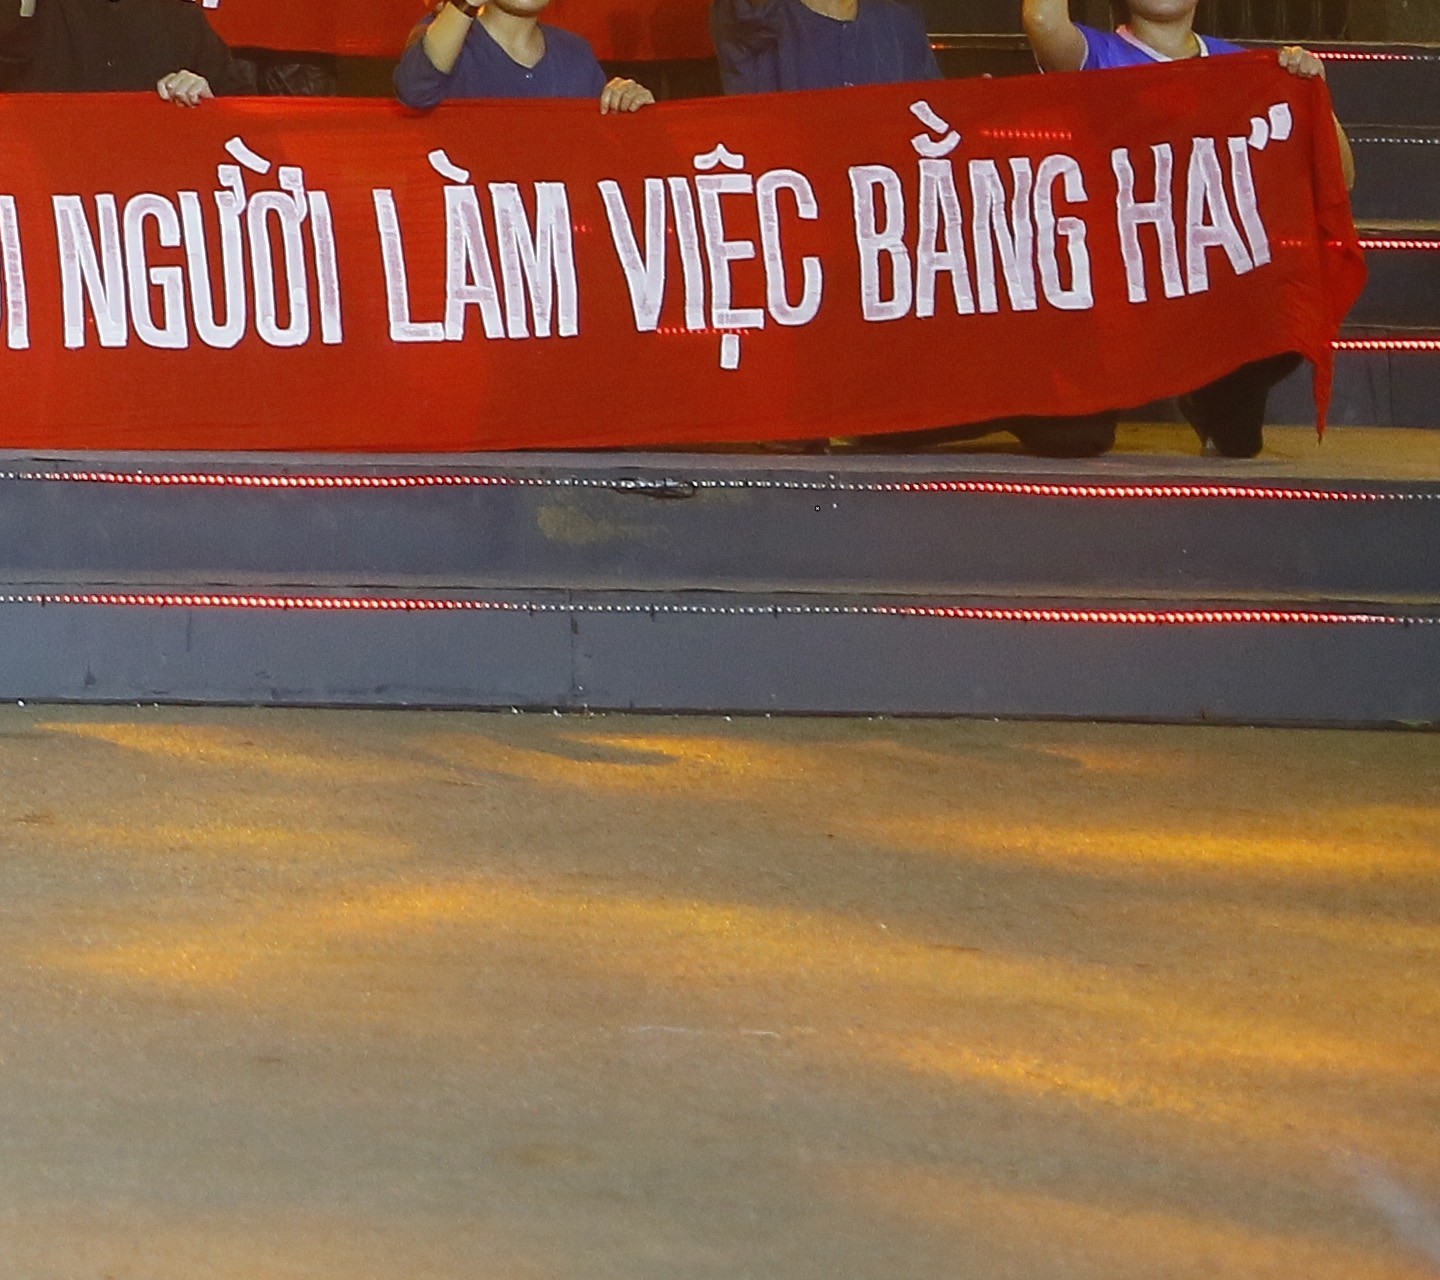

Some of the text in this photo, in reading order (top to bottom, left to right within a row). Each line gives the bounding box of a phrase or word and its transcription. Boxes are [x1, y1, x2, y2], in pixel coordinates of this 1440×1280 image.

[51, 135, 344, 351] NGƯỜI
[372, 147, 580, 344] LÀM
[598, 143, 823, 371] VIỆC
[849, 98, 1094, 324] BẰNG
